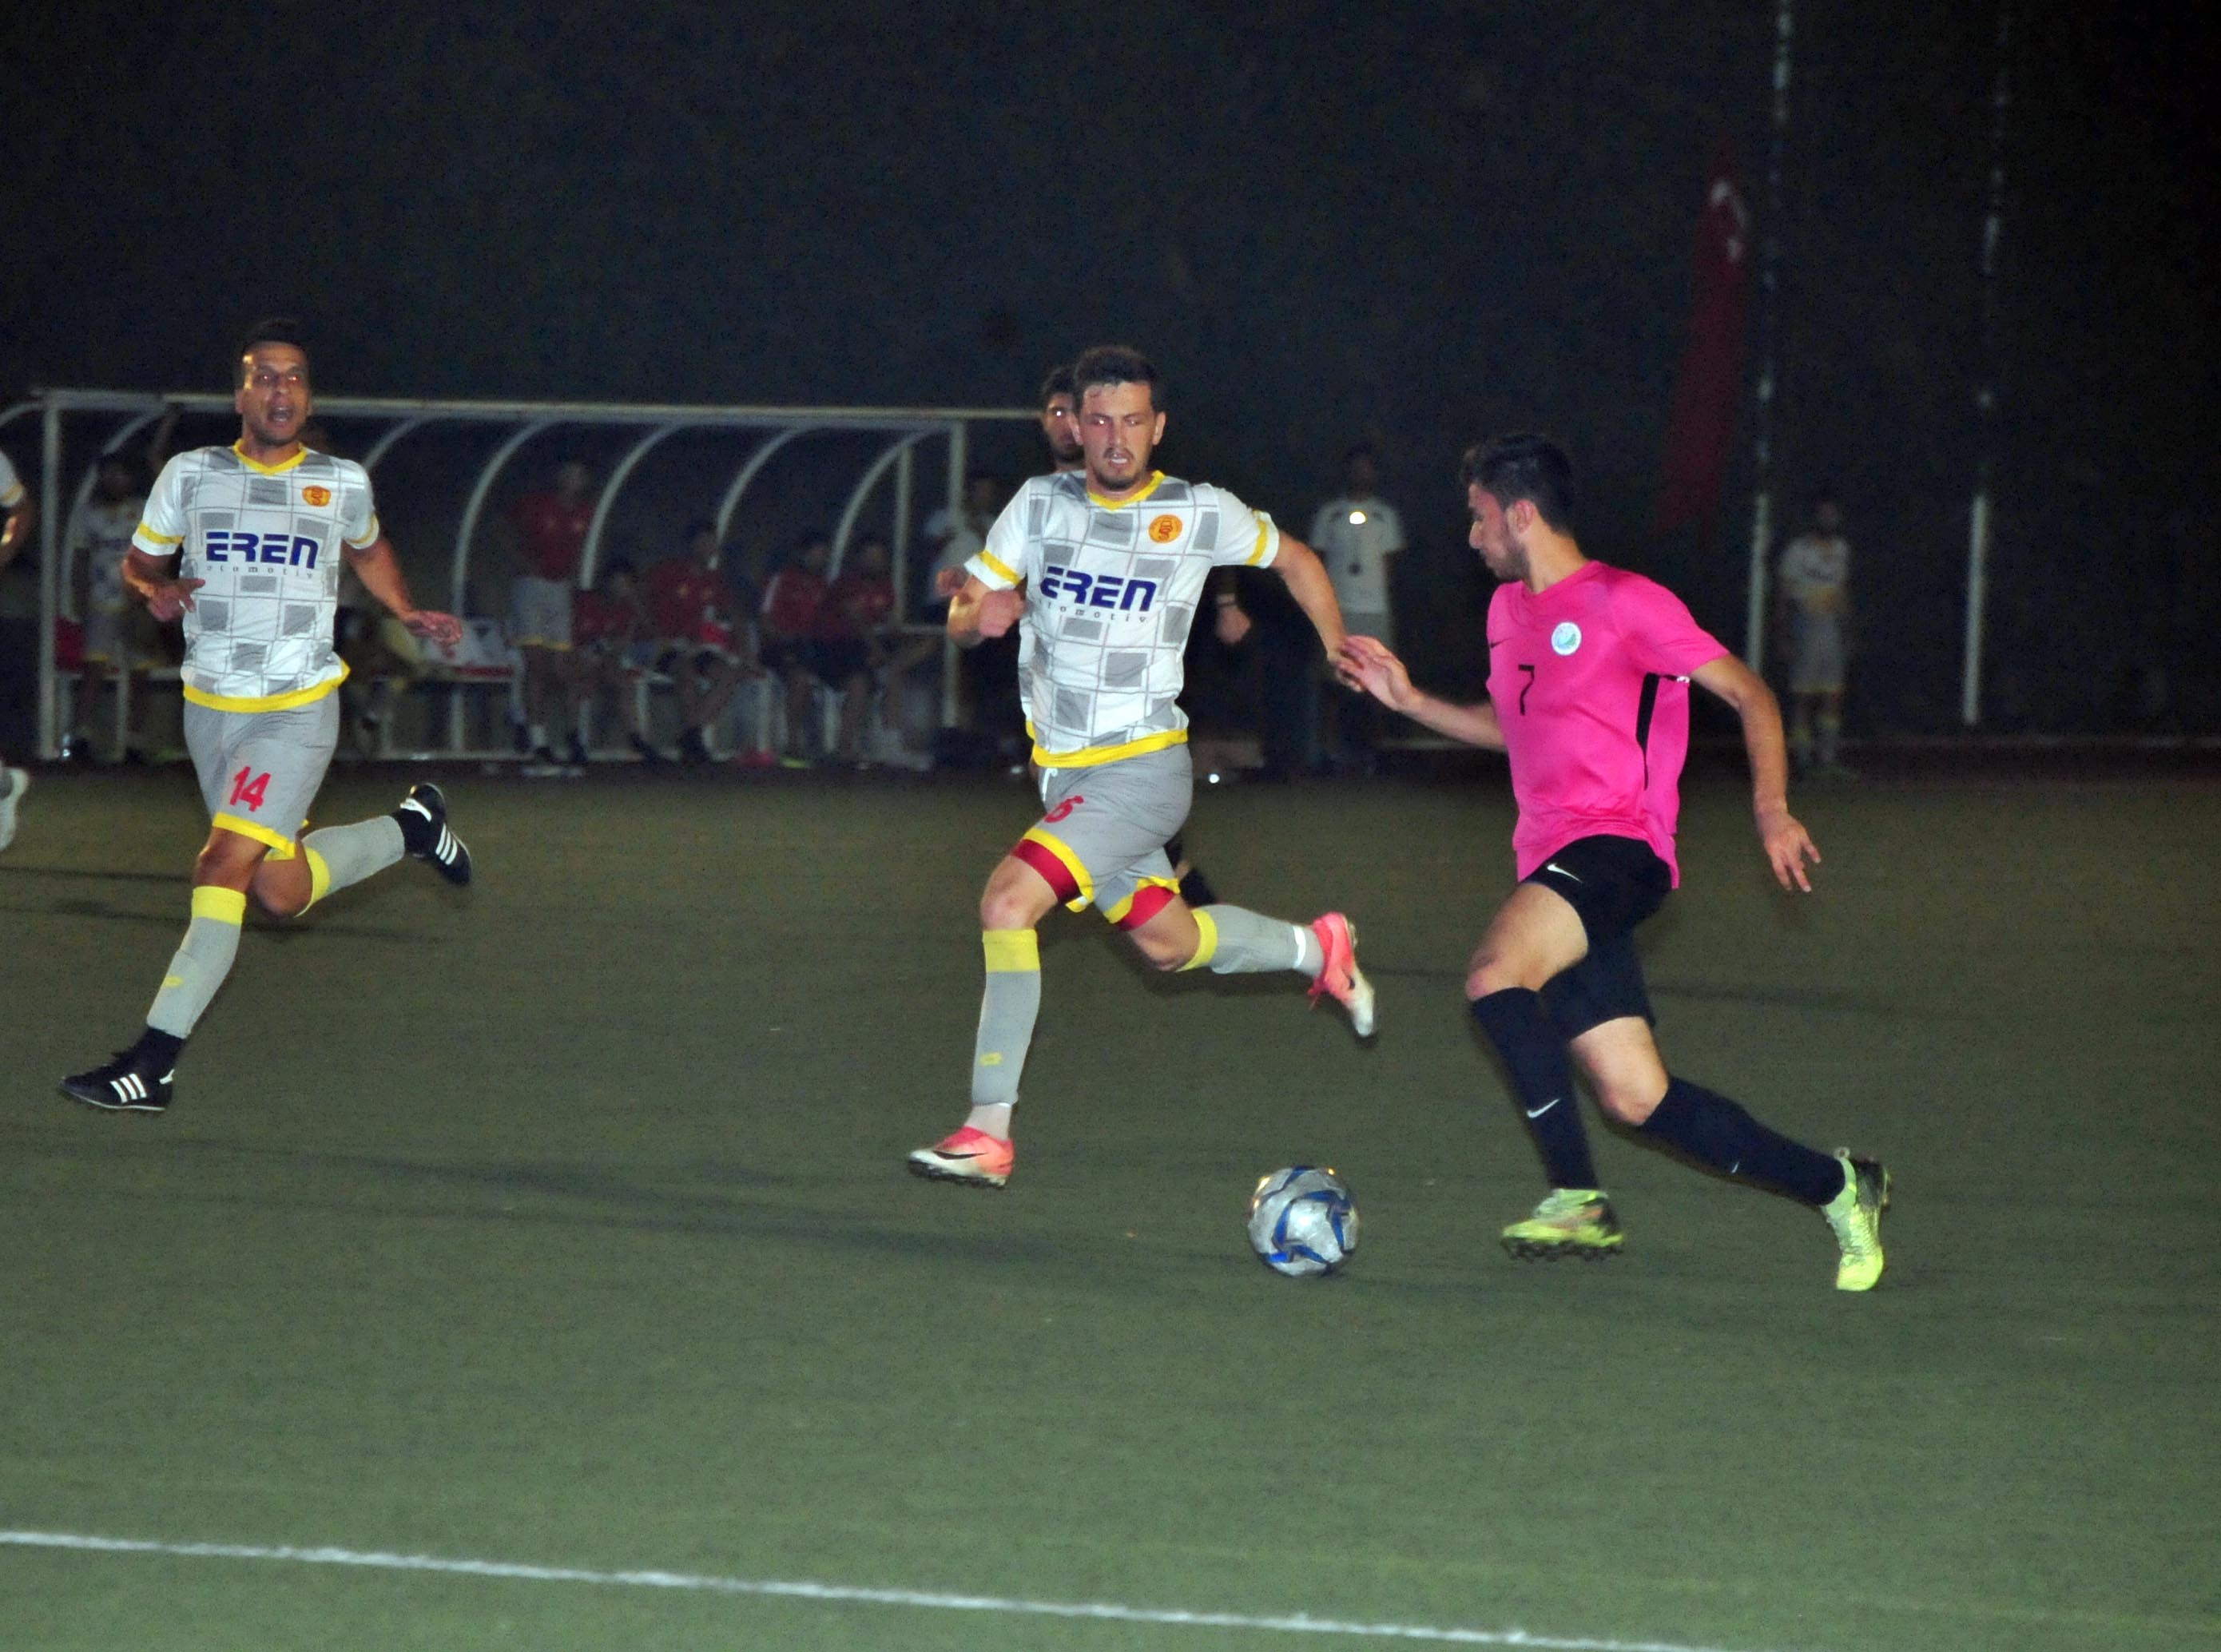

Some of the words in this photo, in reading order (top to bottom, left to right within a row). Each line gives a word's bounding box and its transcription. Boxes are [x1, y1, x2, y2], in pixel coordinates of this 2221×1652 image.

[206, 531, 319, 570] EREN
[1519, 665, 1535, 716] 7
[229, 766, 272, 812] 14
